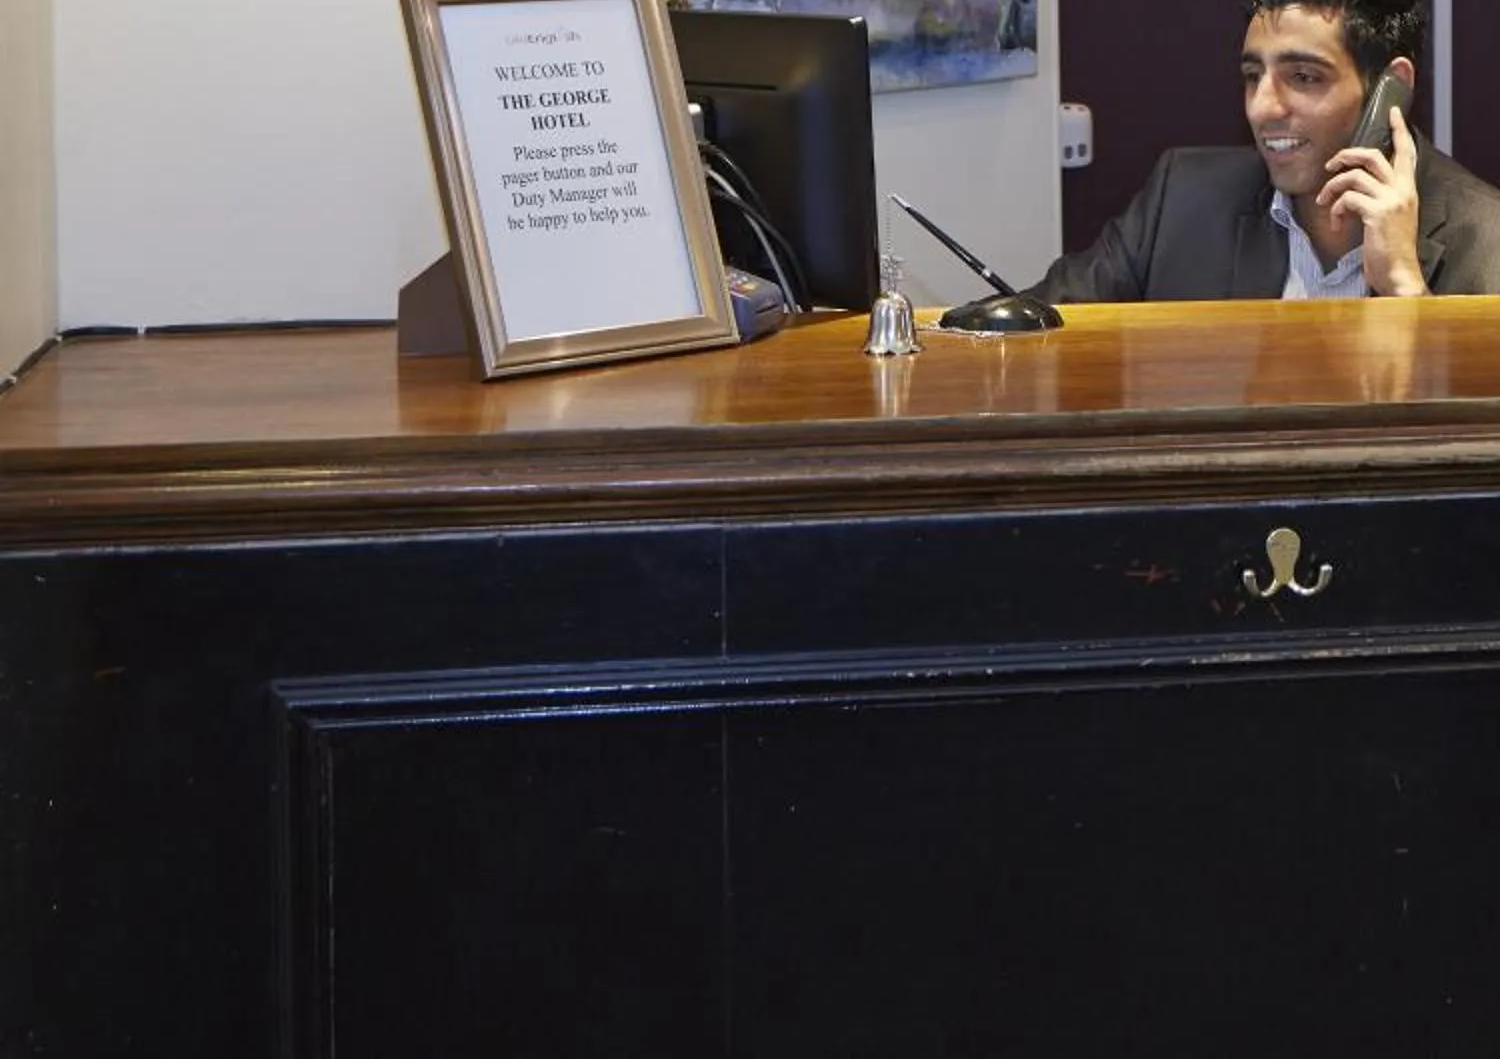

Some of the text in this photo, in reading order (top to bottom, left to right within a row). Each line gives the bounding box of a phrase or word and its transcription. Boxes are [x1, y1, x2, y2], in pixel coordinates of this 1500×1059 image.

[494, 60, 605, 81] WELCOME TO
[498, 89, 611, 110] THE GEORGE
[531, 112, 590, 130] HOTEL
[513, 140, 618, 161] Please press the
[501, 161, 639, 189] pager button and our
[512, 181, 637, 208] Duty Manager will
[507, 214, 525, 230] be
[527, 212, 568, 231] happy
[571, 210, 587, 224] to
[589, 206, 619, 225] help
